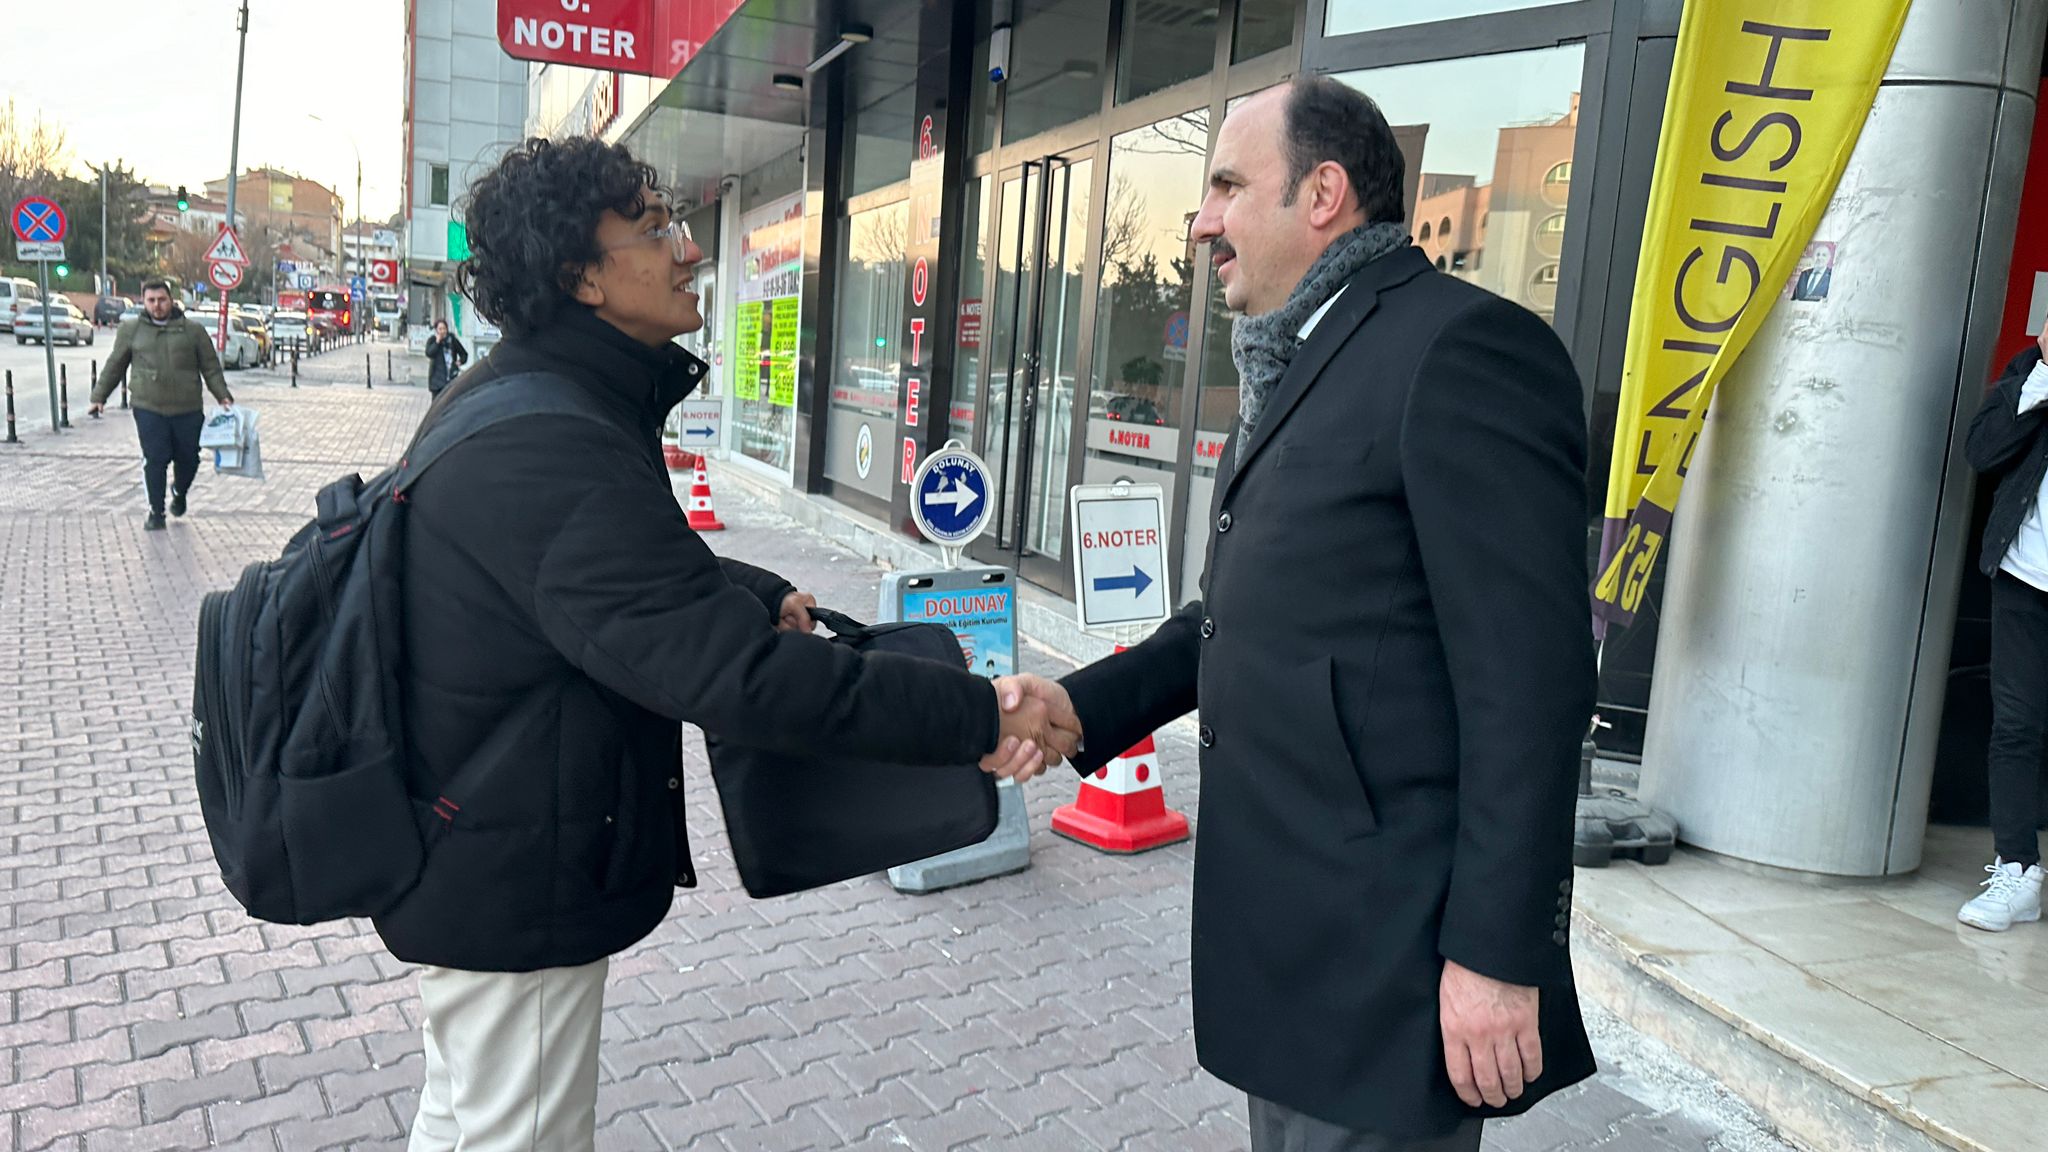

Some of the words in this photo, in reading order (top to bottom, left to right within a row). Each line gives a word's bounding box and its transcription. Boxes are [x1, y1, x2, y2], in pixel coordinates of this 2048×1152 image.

[514, 16, 636, 60] NOTER
[683, 411, 720, 420] 6.NOTER
[1109, 428, 1151, 449] 6.NOTER
[932, 457, 976, 474] DOLUNAY
[1083, 528, 1158, 549] 6.NOTER
[925, 593, 1007, 618] DOLUNAY
[958, 619, 981, 629] Eğitim
